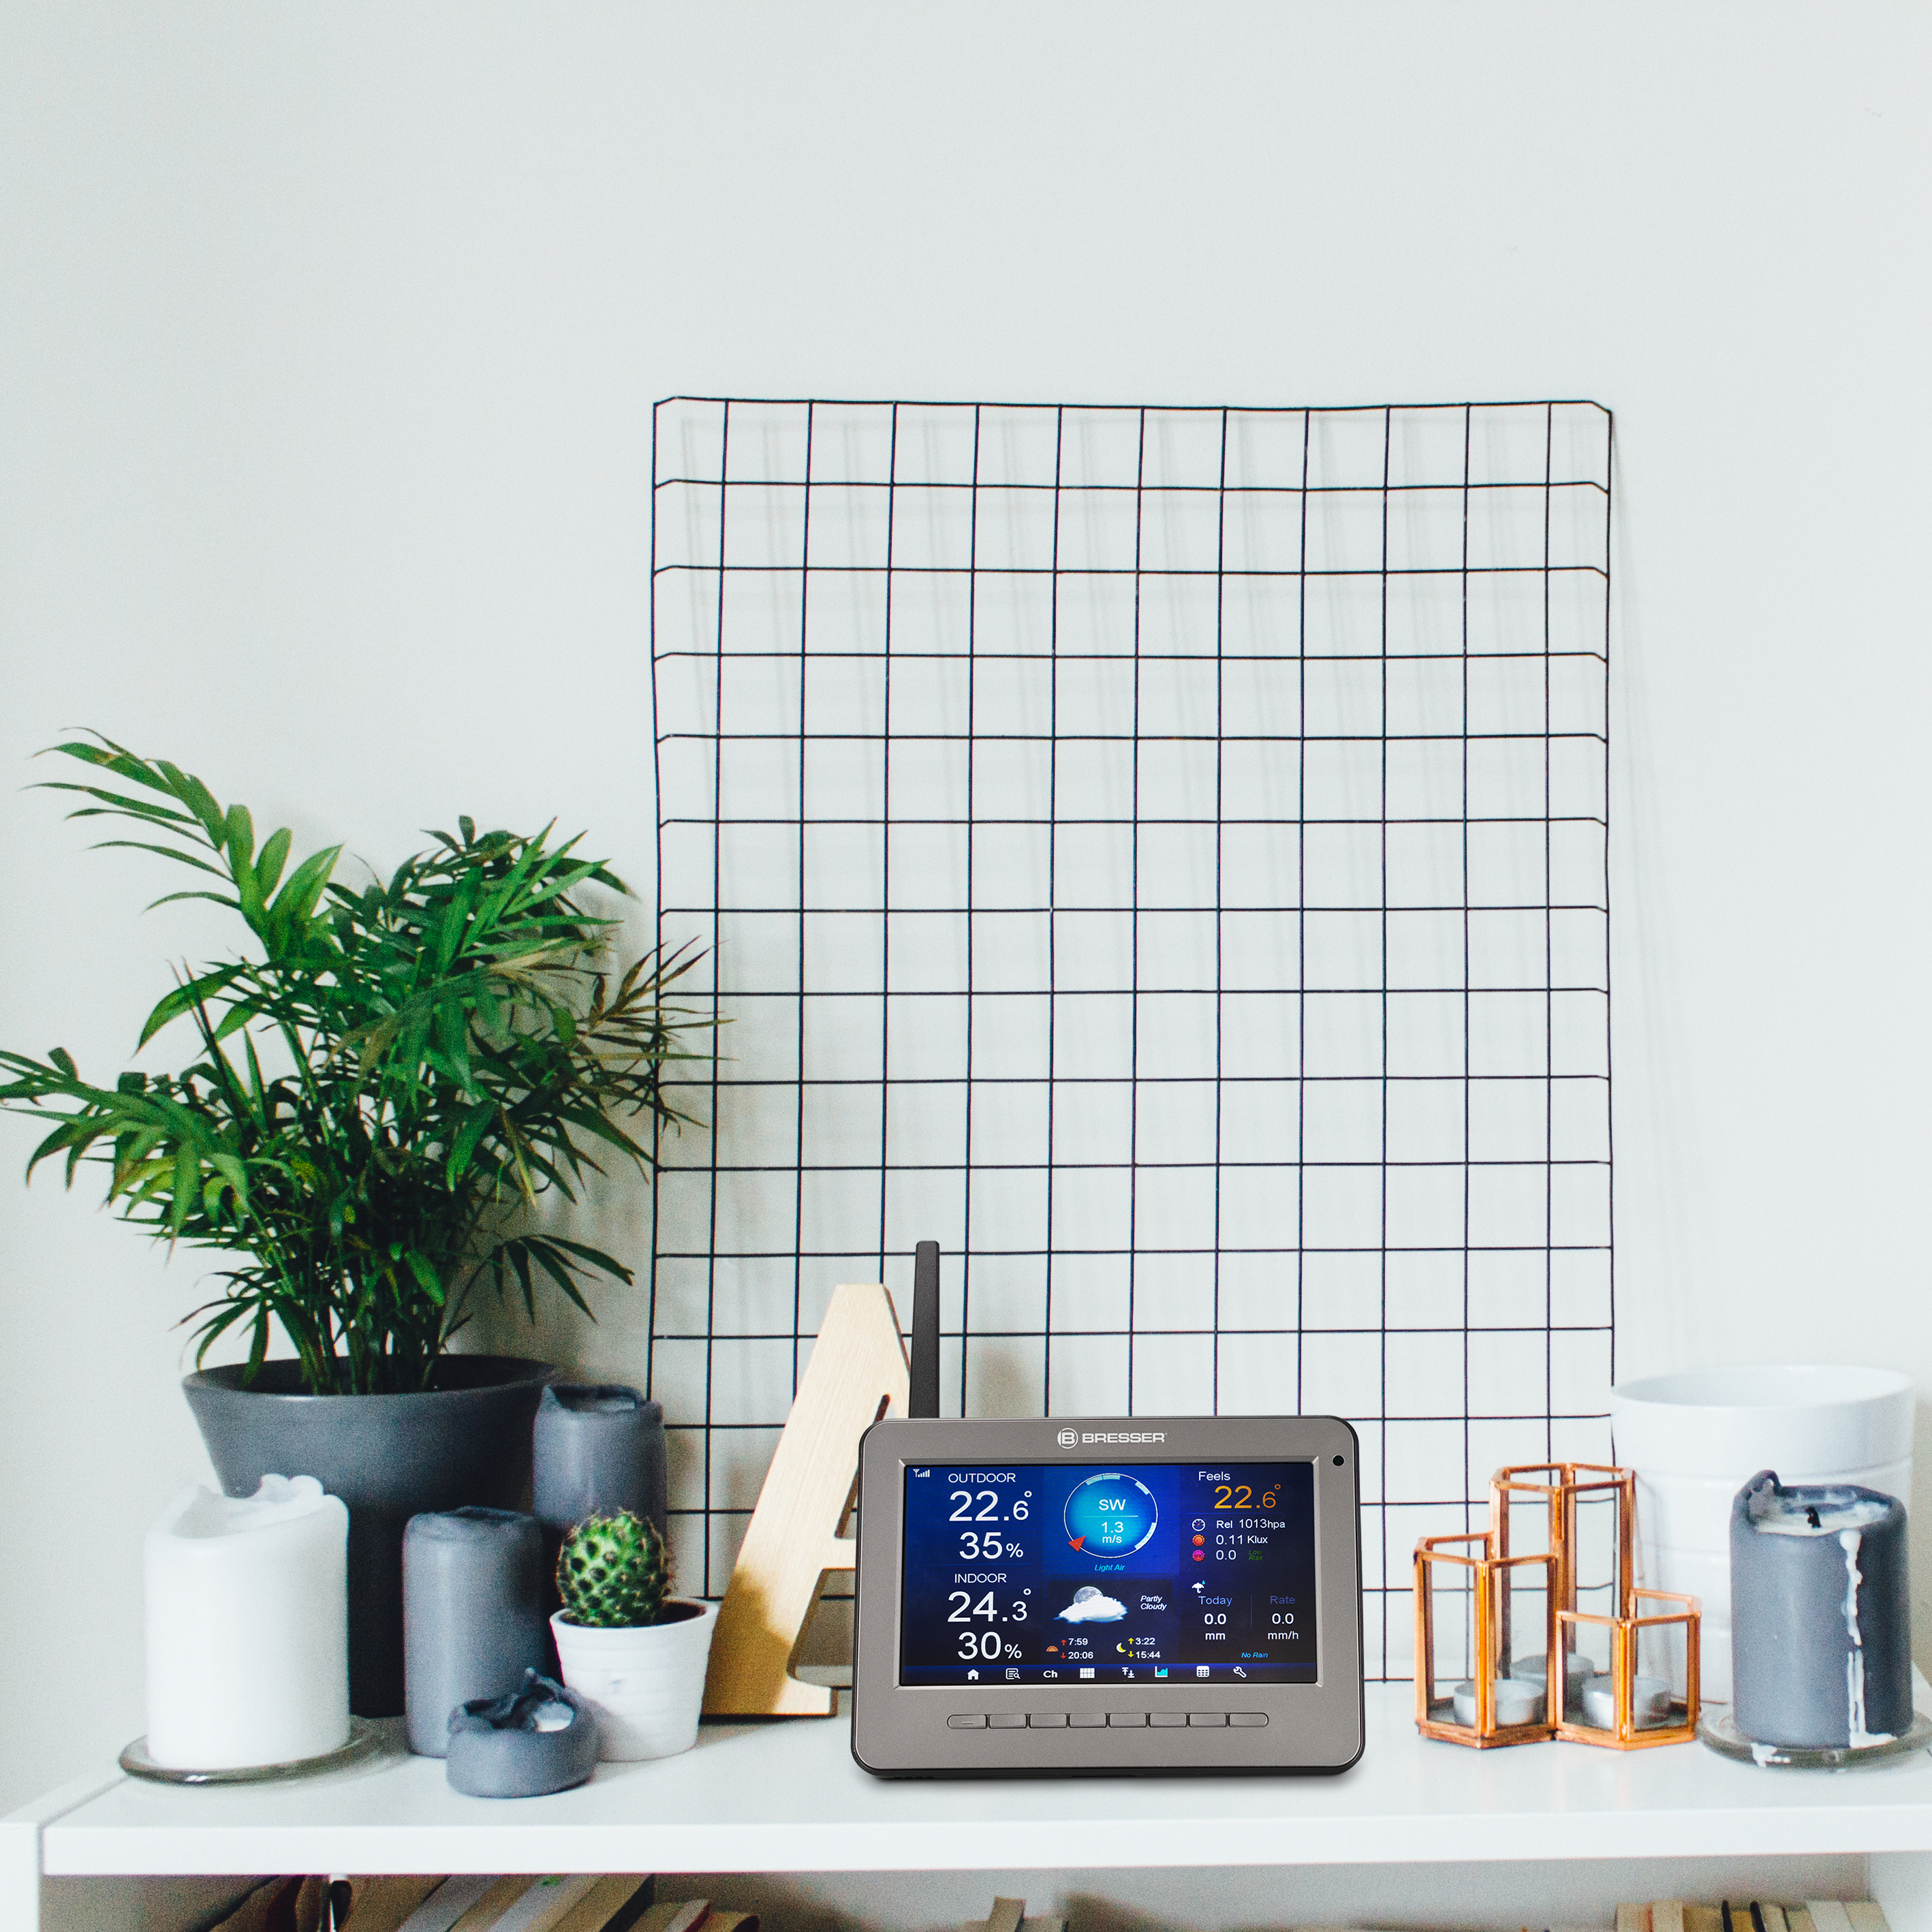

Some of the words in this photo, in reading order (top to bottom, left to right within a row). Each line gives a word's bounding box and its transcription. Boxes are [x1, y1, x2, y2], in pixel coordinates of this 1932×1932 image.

[1082, 1433, 1165, 1443] BRESSER
[948, 1473, 1016, 1483] OUTDOOR
[1198, 1471, 1231, 1481] Feels
[1099, 1499, 1126, 1511] SW
[1102, 1521, 1123, 1533] 1.3
[1216, 1520, 1233, 1529] Rel
[1239, 1518, 1286, 1530] 1013hpa
[1102, 1535, 1122, 1544] m/s
[1215, 1534, 1244, 1545] 0.11
[1247, 1535, 1268, 1544] Klux
[959, 1531, 1023, 1559] 35%
[1215, 1549, 1237, 1561] 0.0
[1094, 1564, 1113, 1572] Light
[954, 1573, 1008, 1583] INDOOR
[1140, 1595, 1163, 1603] Partly
[1198, 1595, 1233, 1607] Today
[1270, 1595, 1296, 1604] Rate
[1140, 1603, 1168, 1611] Cloudy
[1204, 1613, 1227, 1625] 0.0
[1271, 1612, 1294, 1625] 0.0
[1204, 1632, 1226, 1640] mm
[1267, 1631, 1299, 1640] mm/h
[957, 1632, 1023, 1660] 30%
[1068, 1638, 1088, 1646] 7:59
[1068, 1651, 1094, 1660] 20:06
[1136, 1651, 1161, 1659] 15:44
[1043, 1670, 1058, 1678] Ch
